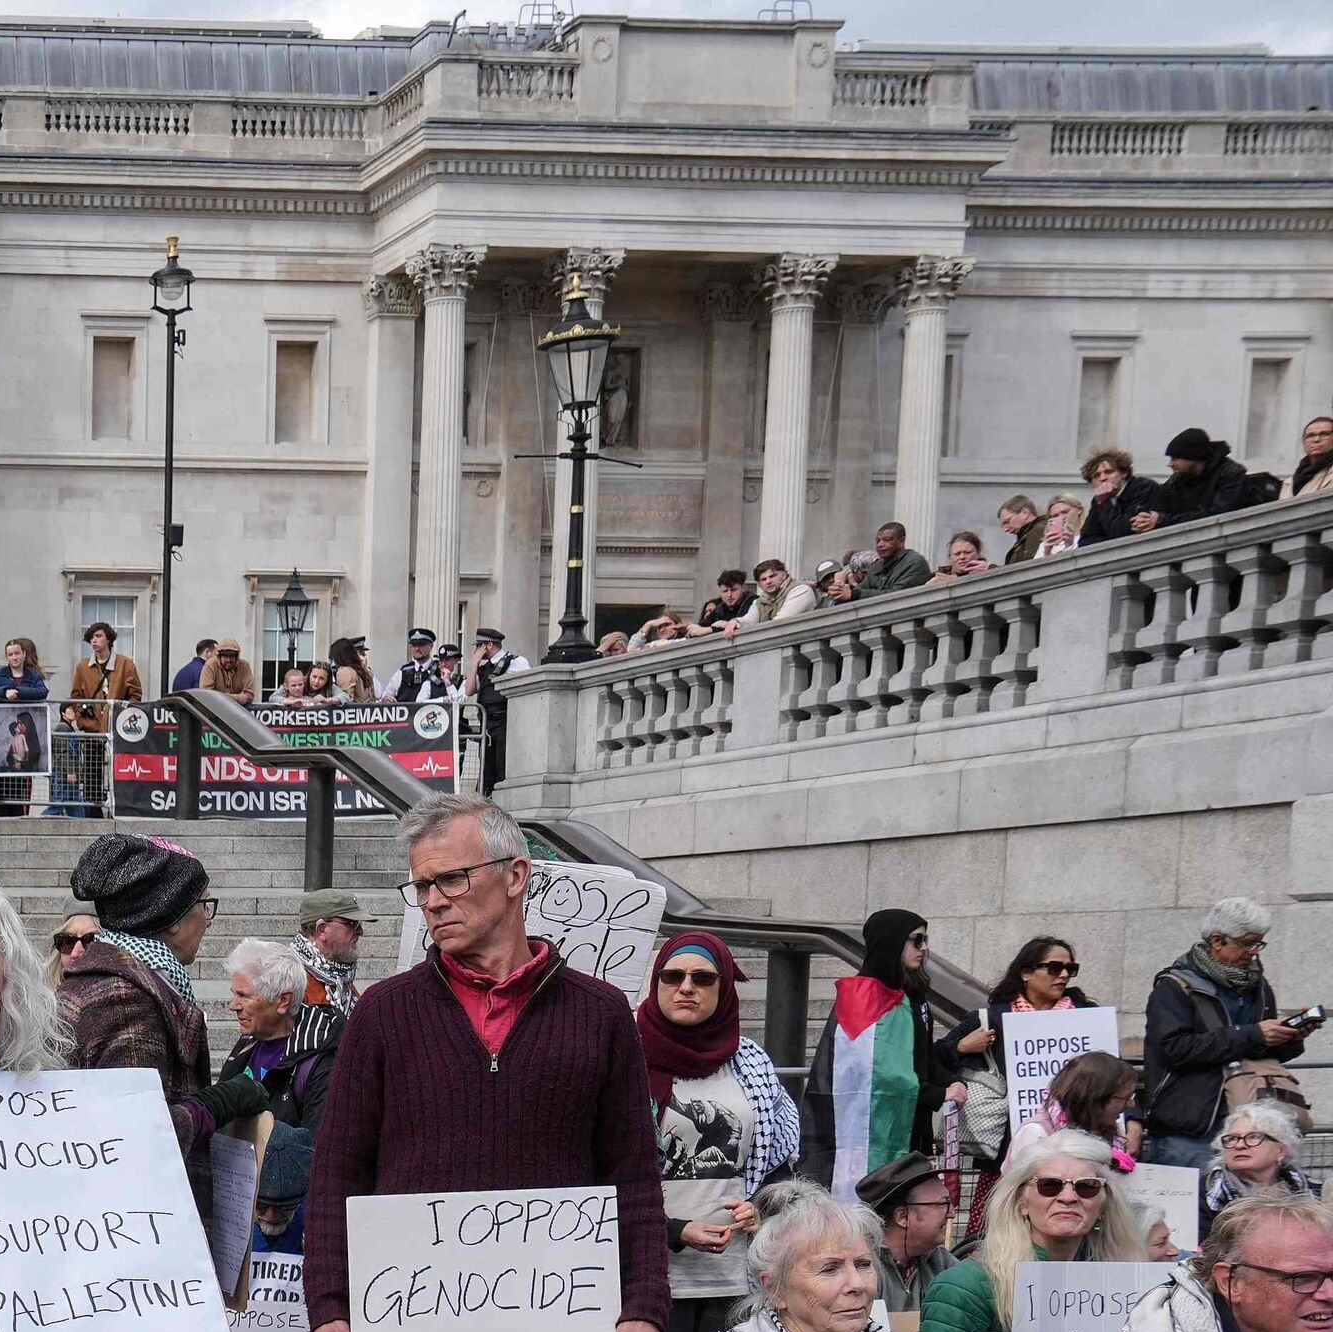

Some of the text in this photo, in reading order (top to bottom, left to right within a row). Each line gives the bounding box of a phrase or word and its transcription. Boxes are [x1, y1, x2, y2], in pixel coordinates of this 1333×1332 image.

[153, 706, 409, 725] UK DEMAND
[335, 730, 392, 747] BANK
[151, 790, 264, 811] SACTION
[1014, 1036, 1091, 1056] I OPPOSE
[427, 1195, 619, 1246] I OPPOSE
[363, 1266, 605, 1325] GENOCIDE
[1027, 1284, 1036, 1322] I
